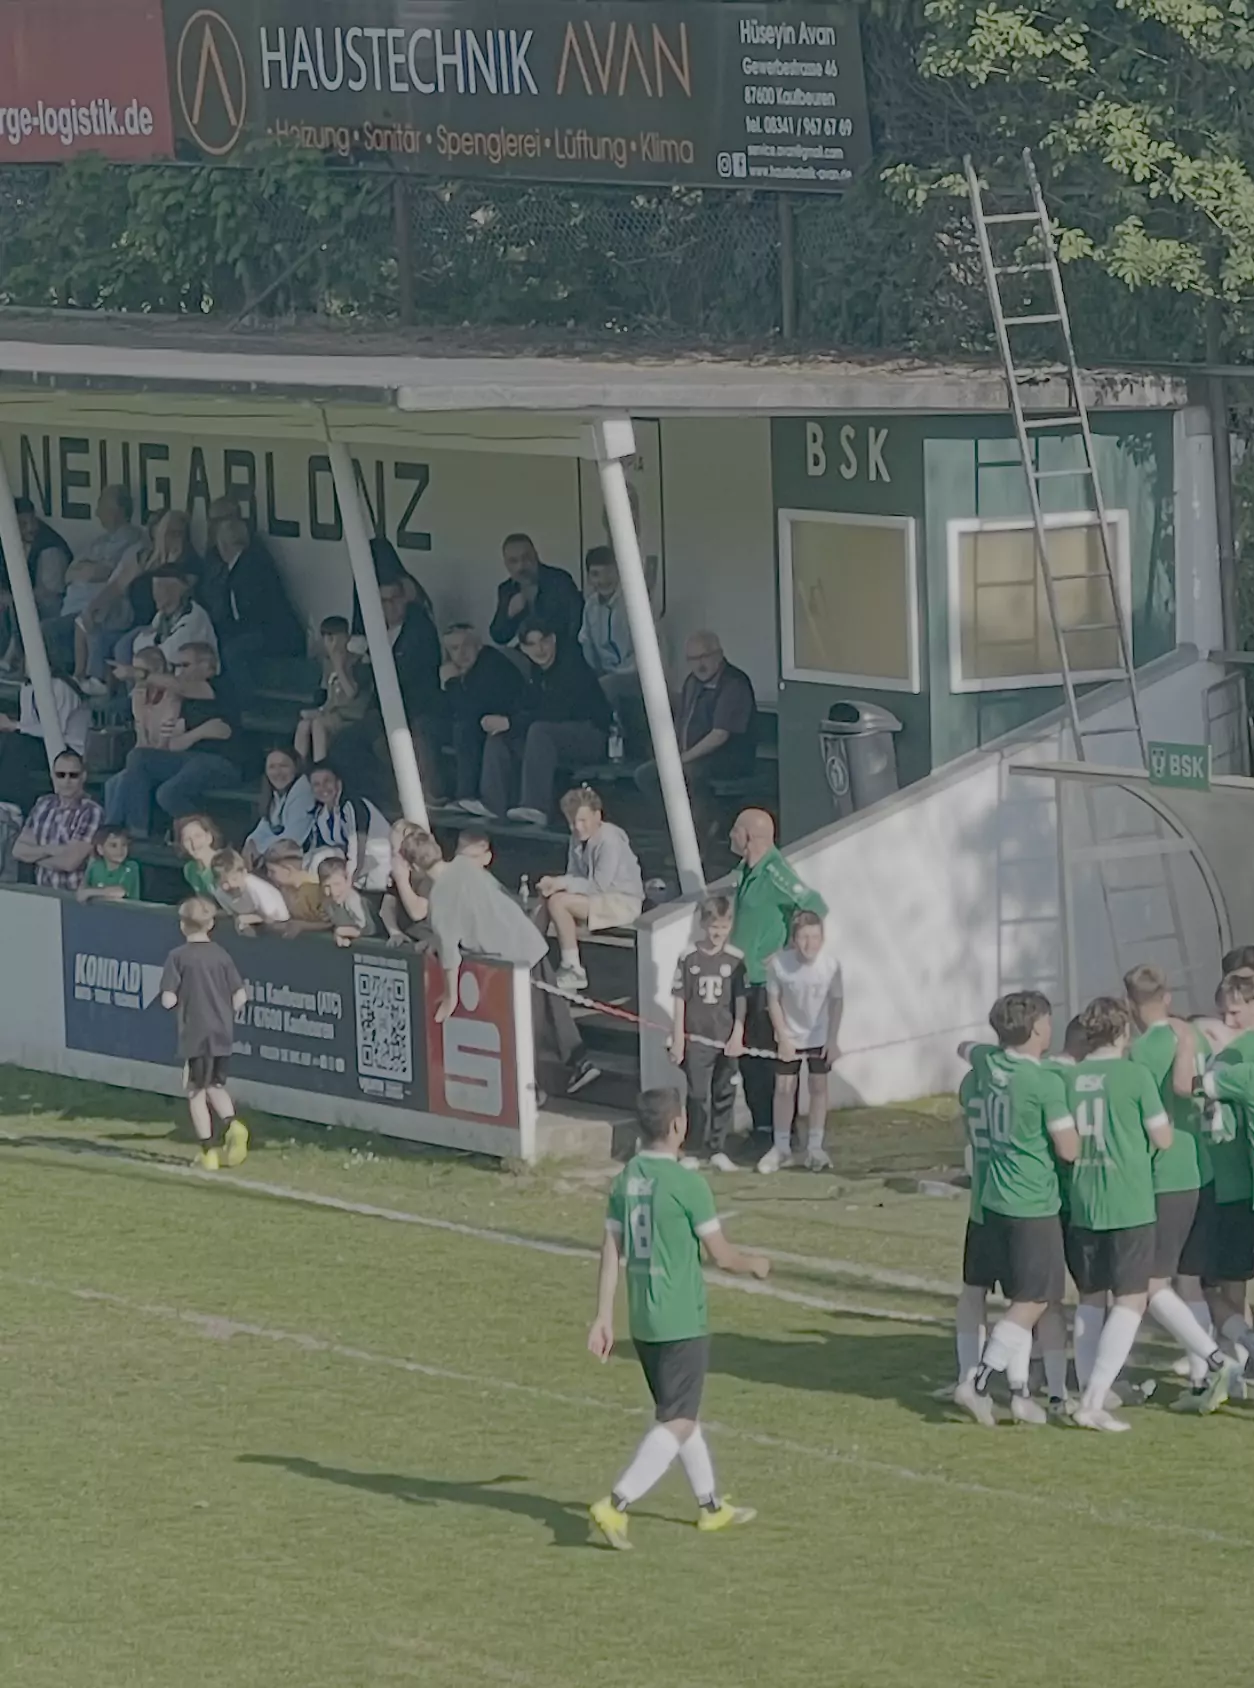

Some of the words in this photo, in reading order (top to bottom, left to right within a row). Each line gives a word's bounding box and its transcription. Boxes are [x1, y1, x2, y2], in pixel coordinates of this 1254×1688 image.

[740, 19, 796, 49] Hüseyin
[799, 21, 836, 46] Avan
[260, 26, 539, 95] HAUSTECHNIK
[557, 20, 692, 98] AVAN
[744, 86, 775, 105] 87600
[776, 87, 836, 106] Kaufbeuren
[364, 121, 421, 153] Sanitär
[437, 124, 541, 164] Spenglerei
[555, 129, 627, 168] Lüftung
[641, 131, 693, 164] Klima
[806, 421, 891, 482] BSK
[1169, 754, 1205, 779] BSK
[75, 953, 140, 993] KONRAD
[1075, 1097, 1107, 1152] 4
